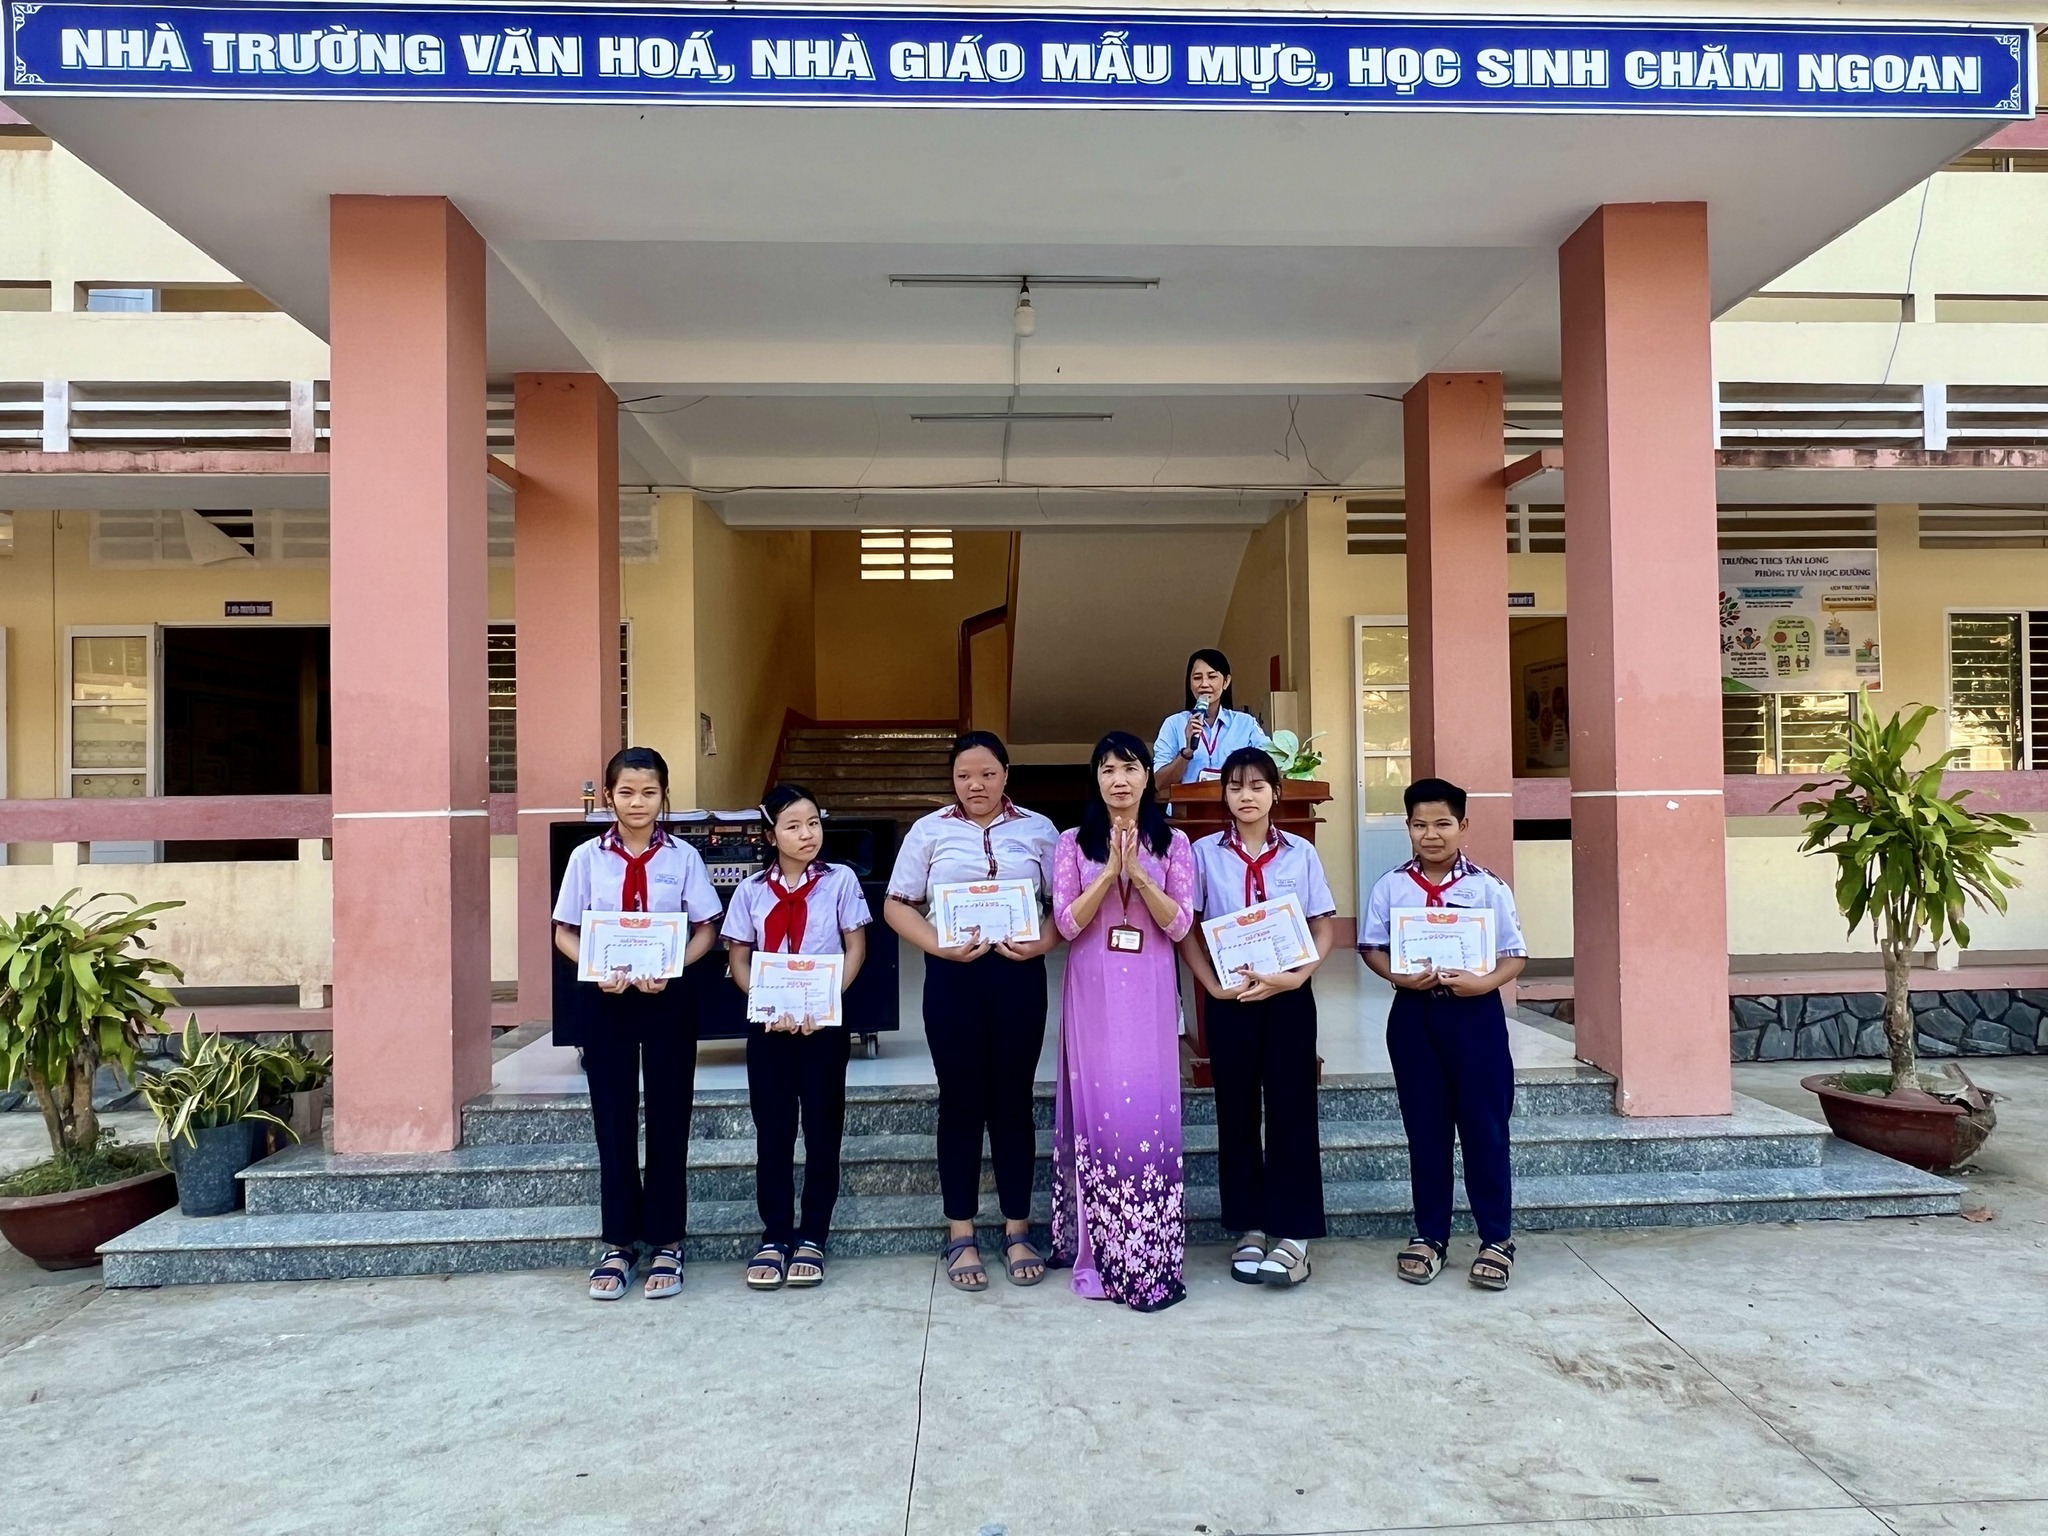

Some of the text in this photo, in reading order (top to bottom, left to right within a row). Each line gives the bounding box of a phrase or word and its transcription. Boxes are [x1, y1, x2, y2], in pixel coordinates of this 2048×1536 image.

[61, 22, 1981, 95] NHÀ TRƯỜNG VĂN HOÁ, NHÀ GIÁO MẪU MỰC, HỌC SINH CHĂM NGOAN
[1721, 555, 1829, 565] TRƯỜNG THCS TÂN LONG
[1754, 568, 1785, 577] PHÒNG
[1786, 569, 1799, 577] TƯ
[1818, 569, 1838, 578] HỌC
[1839, 568, 1871, 577] ĐƯỜNG
